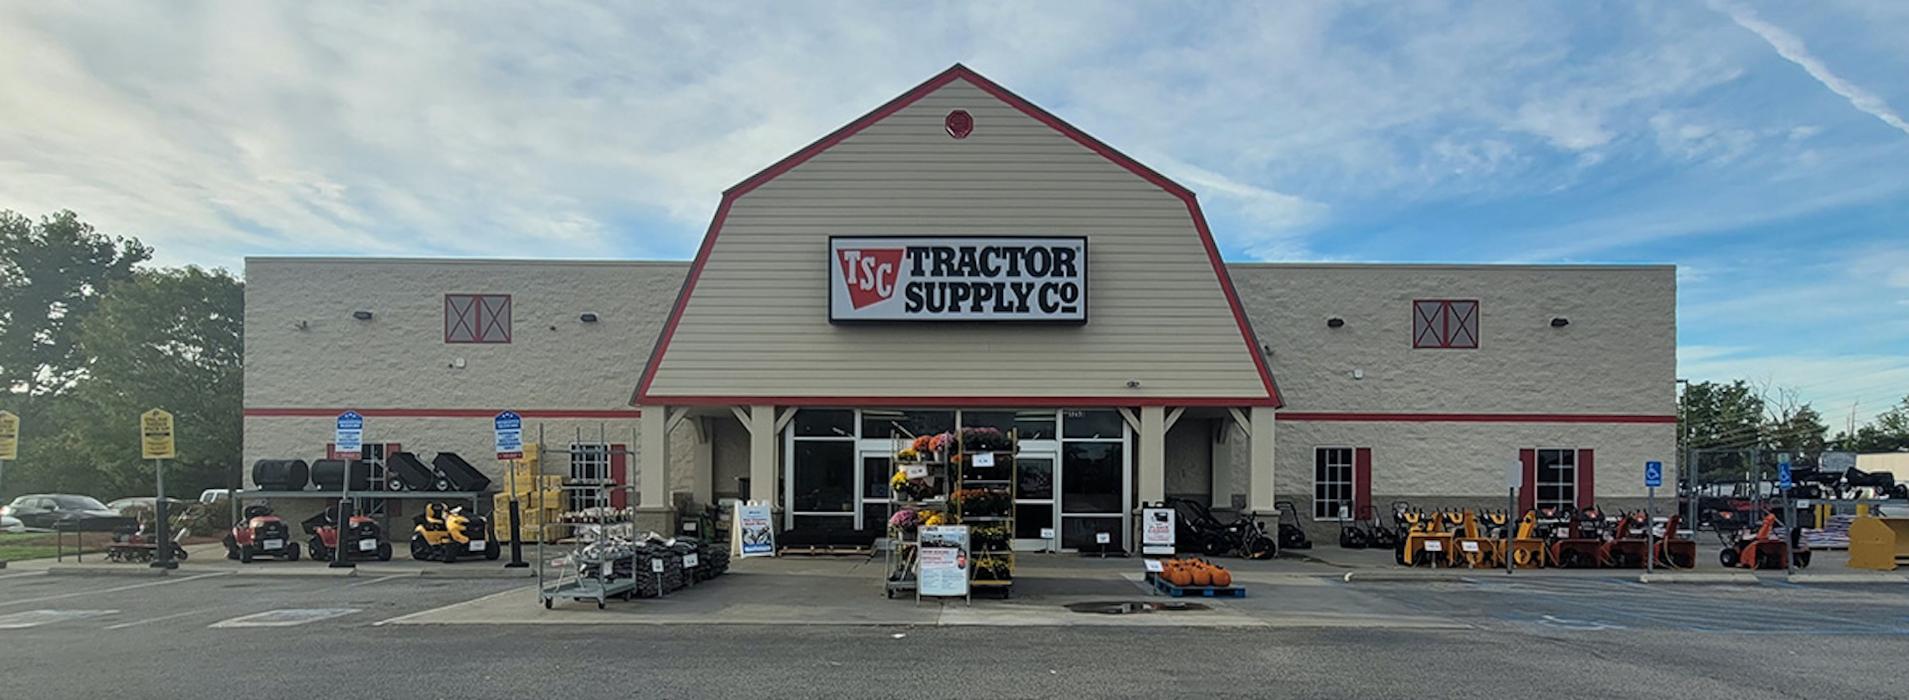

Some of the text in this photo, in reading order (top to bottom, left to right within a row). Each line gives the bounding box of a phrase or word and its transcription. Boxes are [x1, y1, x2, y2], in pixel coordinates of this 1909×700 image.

[844, 251, 892, 298] TSC
[906, 246, 1077, 278] TRACTOR
[905, 282, 1035, 313] SUPPLY
